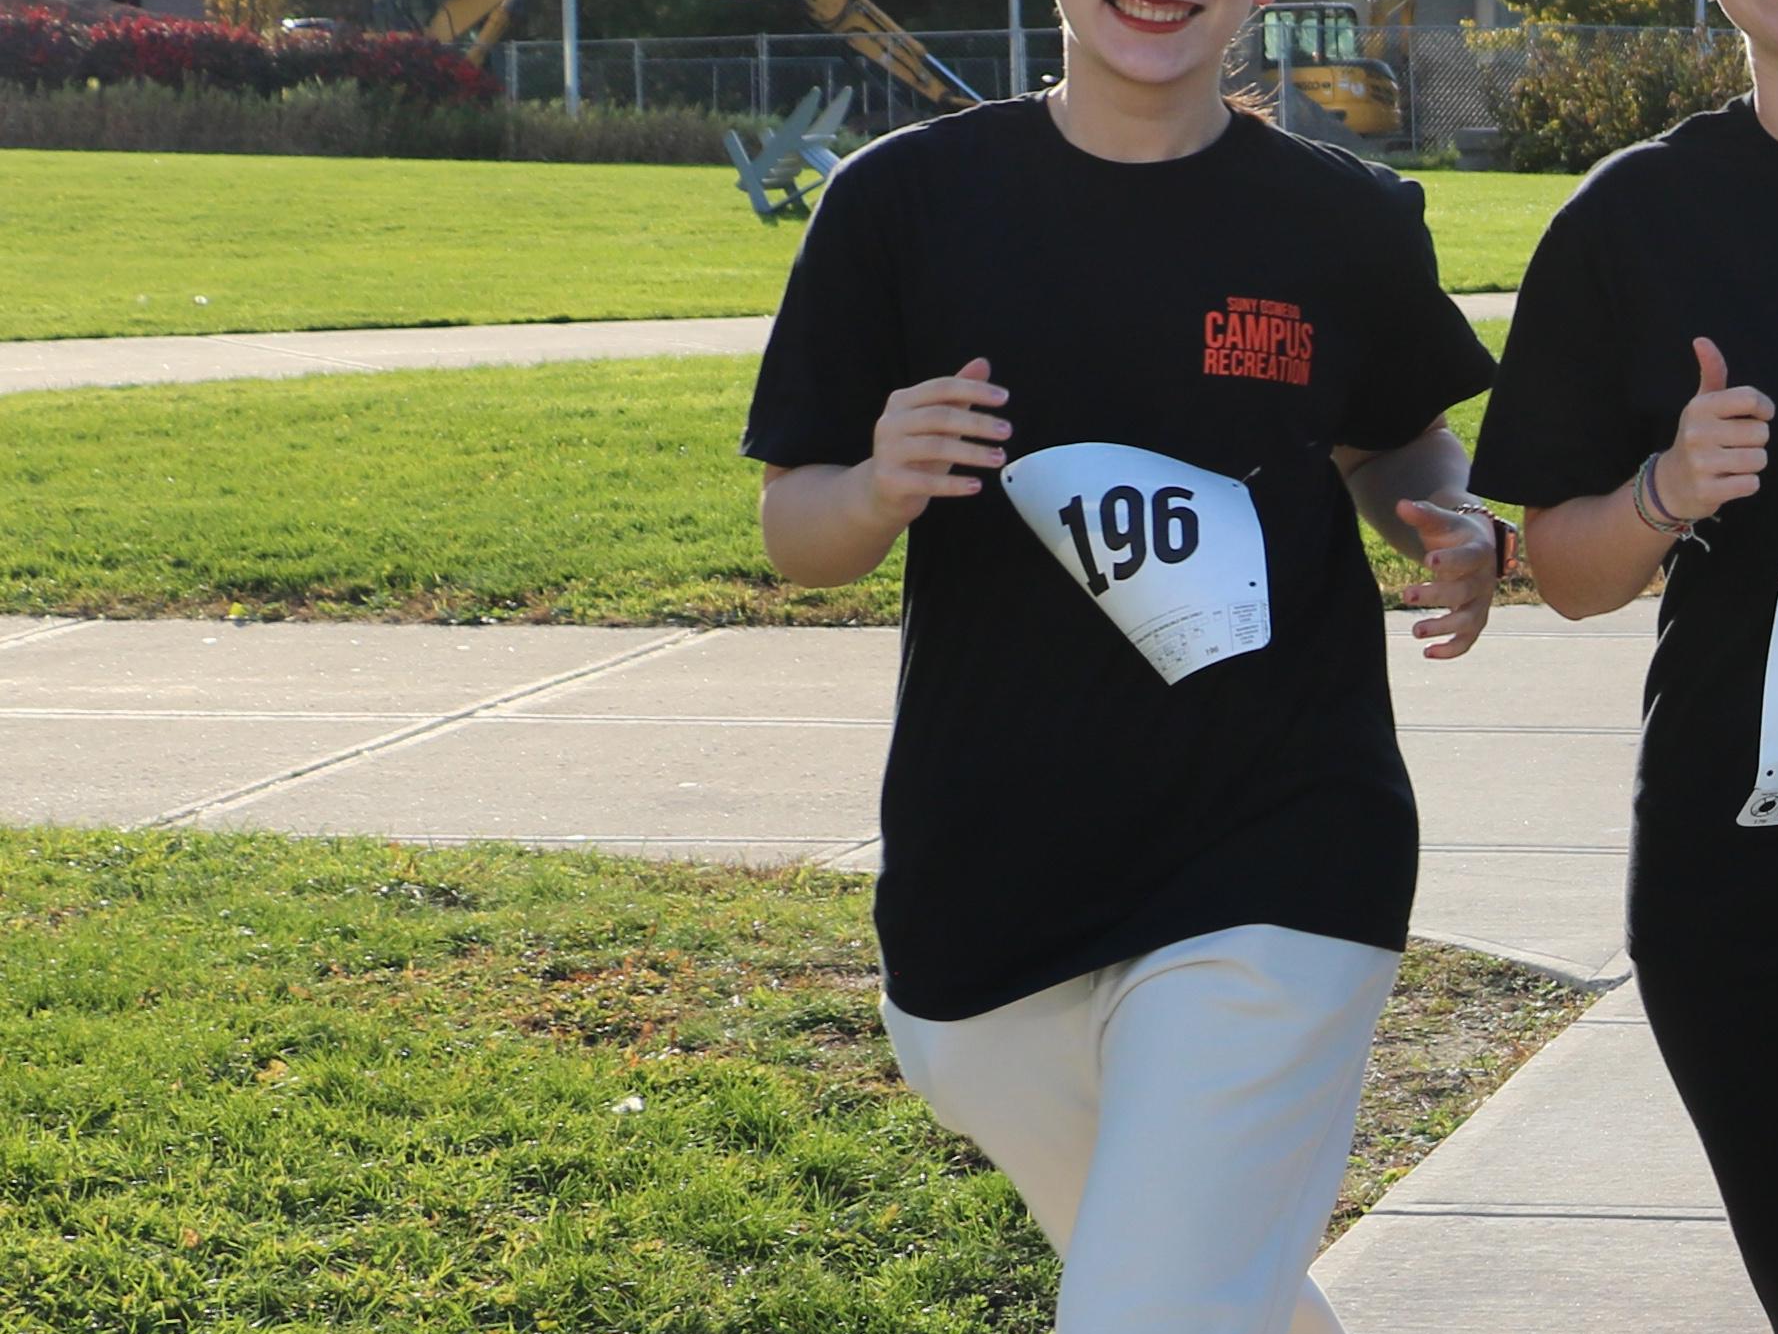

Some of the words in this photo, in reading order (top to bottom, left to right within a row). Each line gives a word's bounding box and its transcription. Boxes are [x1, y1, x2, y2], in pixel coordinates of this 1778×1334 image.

[1204, 310, 1314, 360] CAMPUS
[1203, 348, 1312, 386] RECREATION
[1058, 485, 1199, 597] 196
